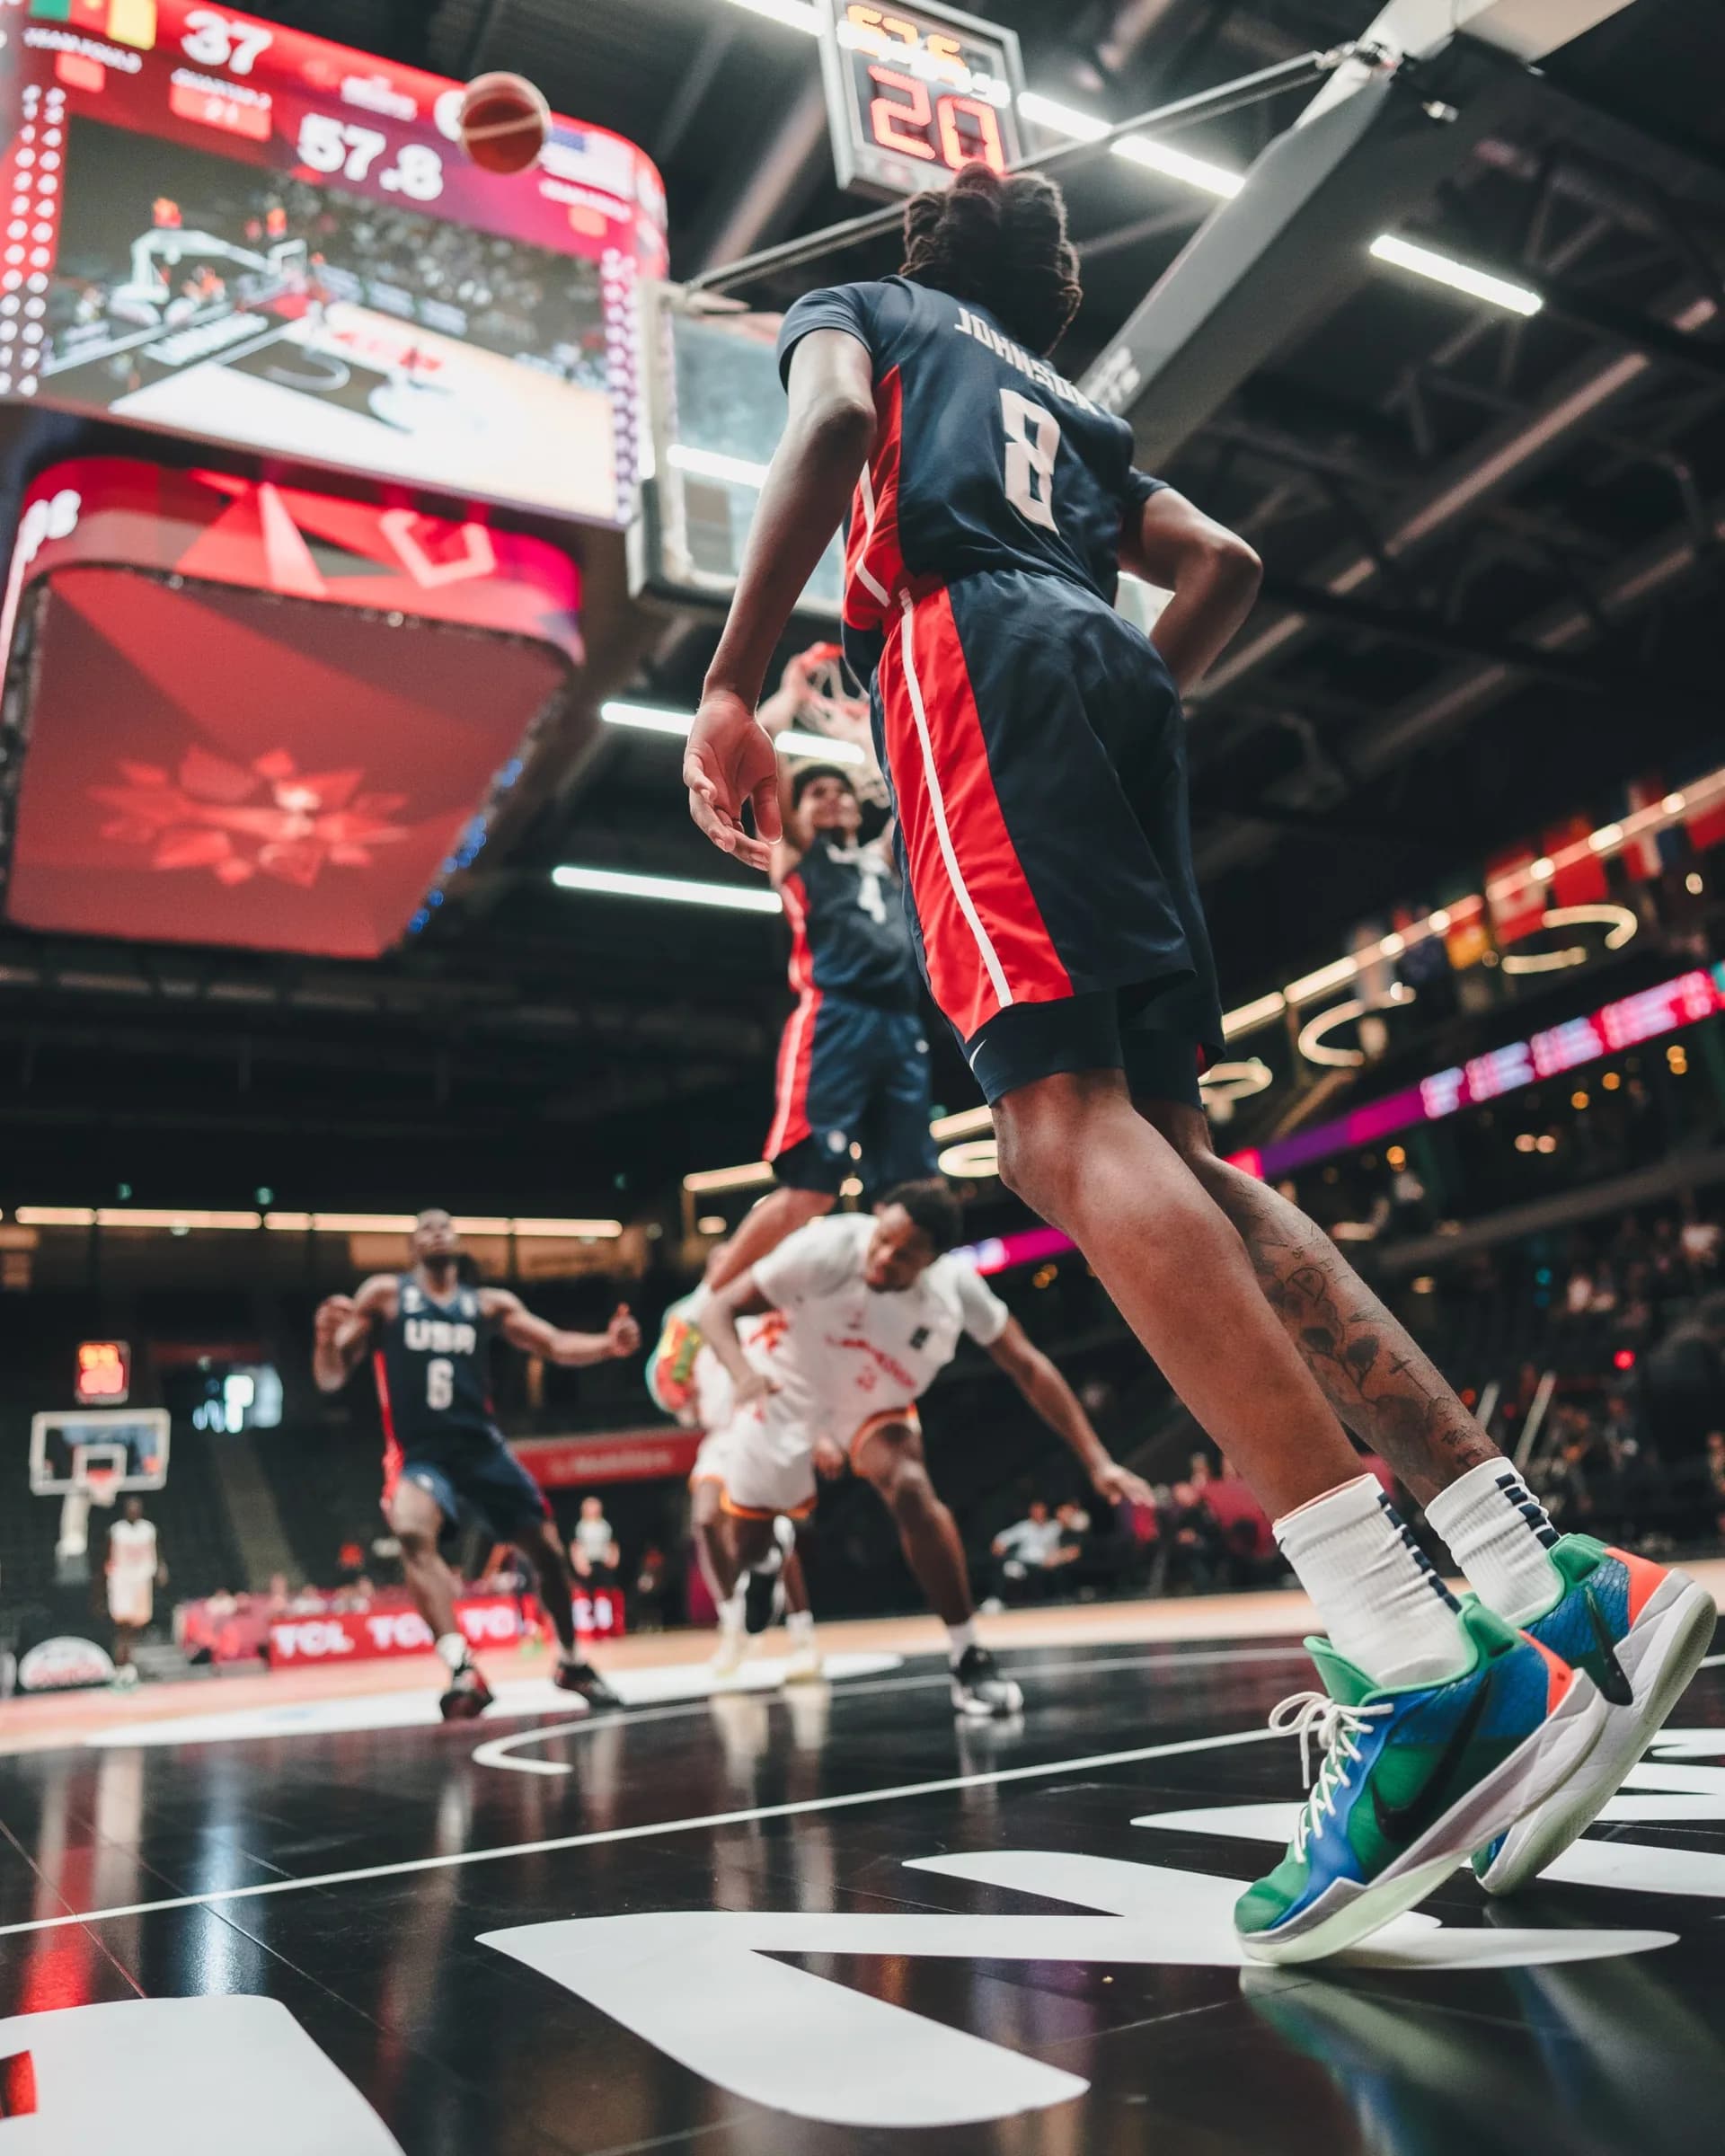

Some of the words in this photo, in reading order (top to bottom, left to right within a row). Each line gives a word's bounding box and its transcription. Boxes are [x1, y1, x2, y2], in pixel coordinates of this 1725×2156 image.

[181, 10, 273, 75] 37
[297, 112, 443, 200] 57.8
[868, 65, 1005, 174] 20
[999, 388, 1061, 536] 8
[272, 1621, 356, 1658] TCL
